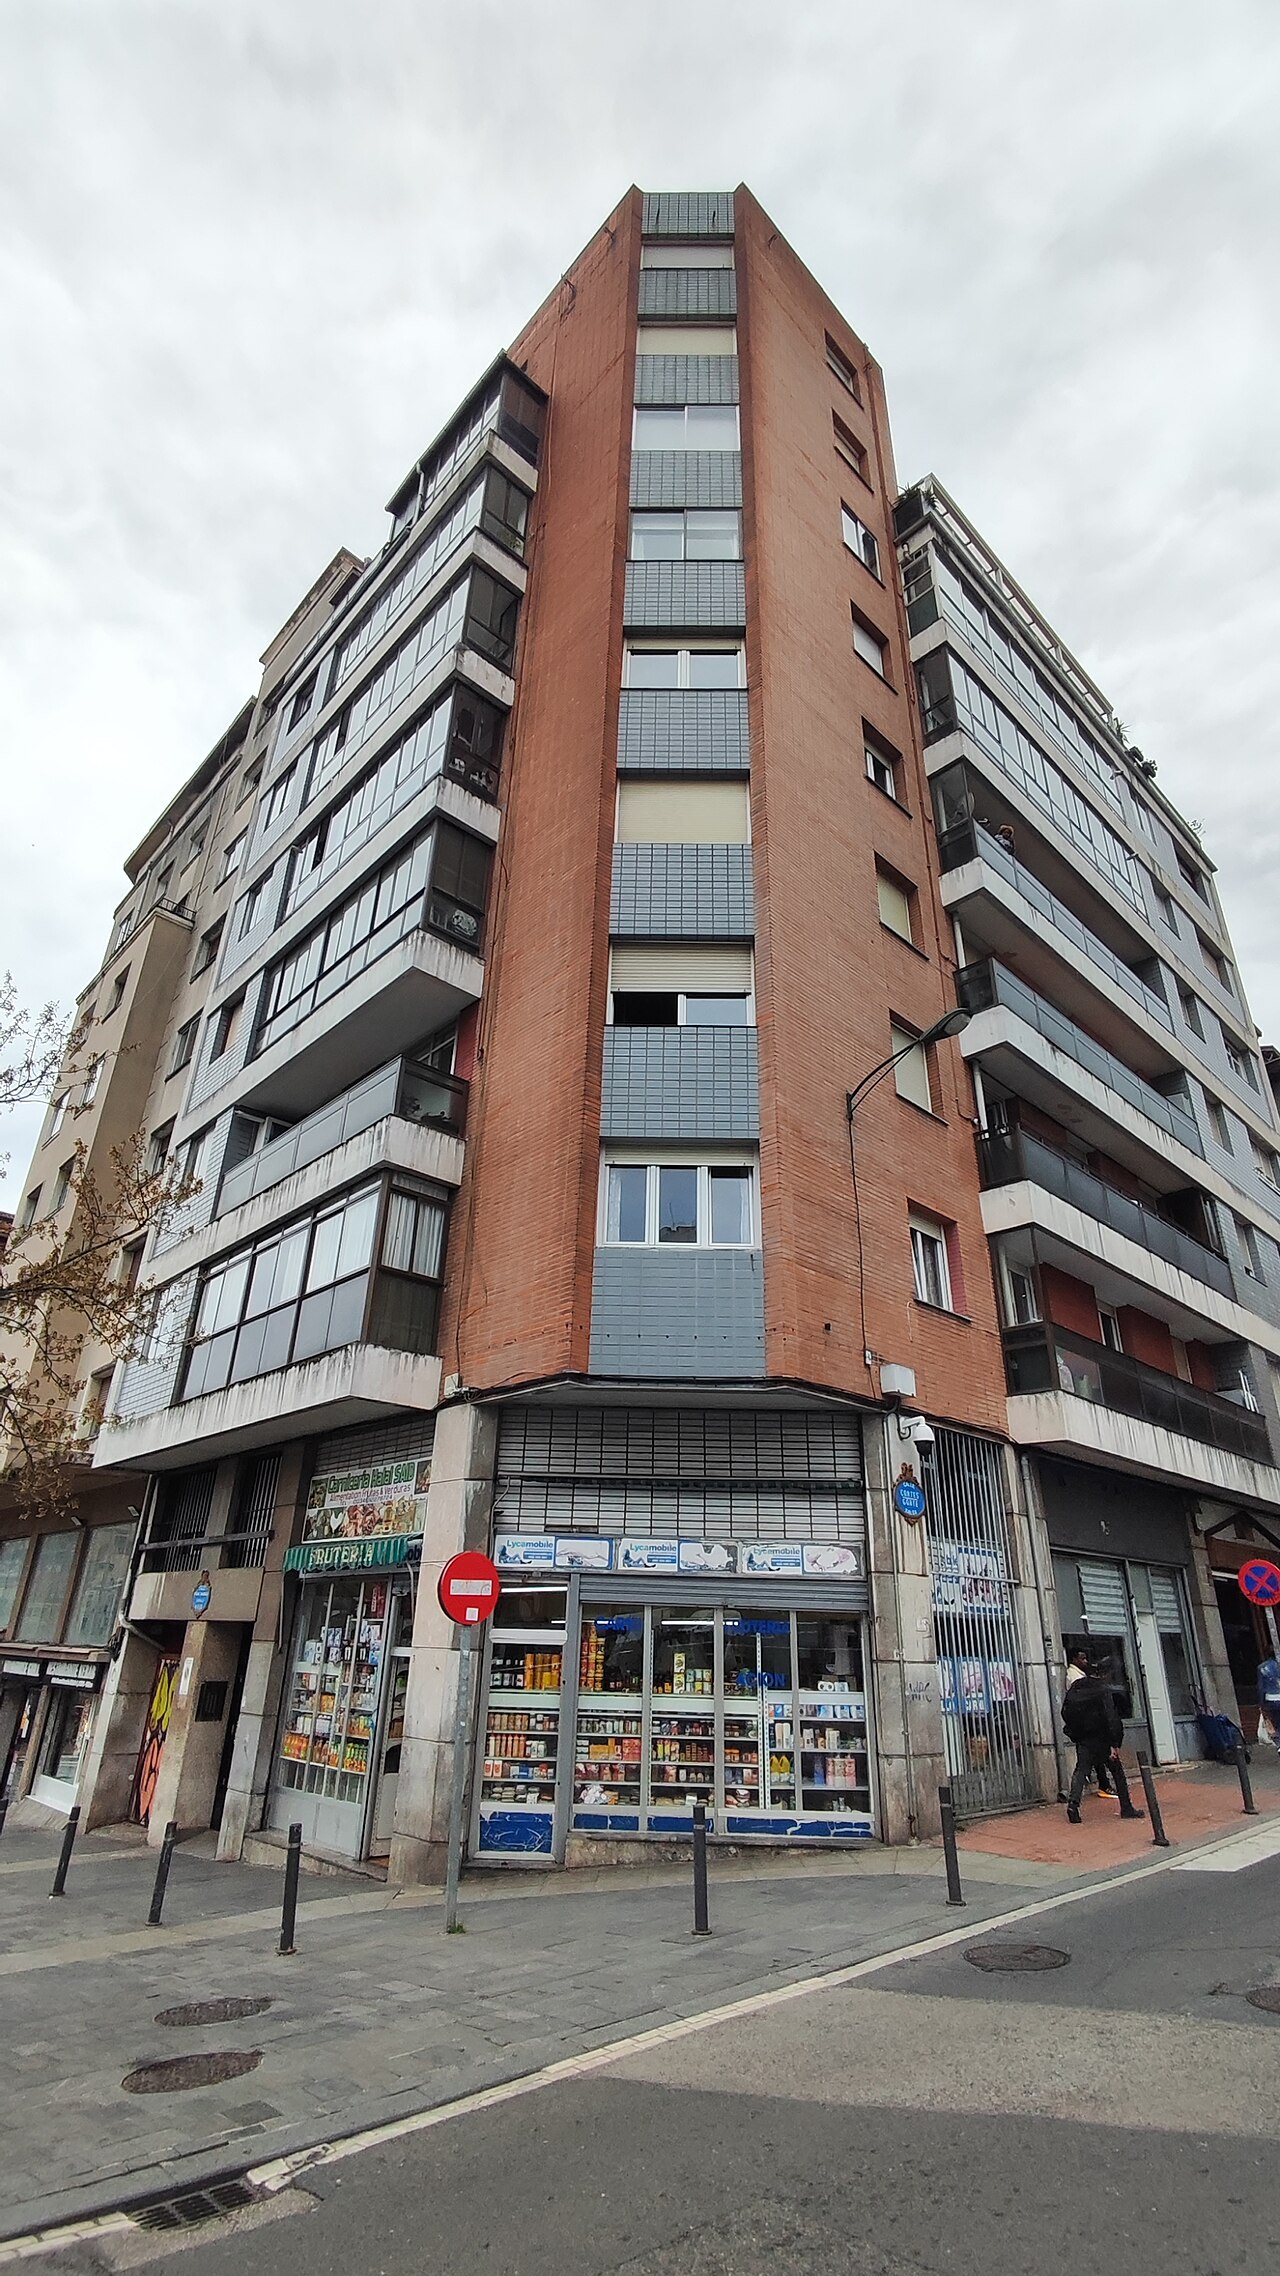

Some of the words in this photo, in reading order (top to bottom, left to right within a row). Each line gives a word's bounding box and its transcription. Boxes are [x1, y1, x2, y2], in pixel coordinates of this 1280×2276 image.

[370, 1465, 394, 1488] Halal
[394, 1462, 416, 1484] SAID
[384, 1484, 411, 1496] Verduras
[900, 1489, 920, 1499] CORTES
[506, 1539, 553, 1549] Lycamobile
[630, 1542, 677, 1552] Lycamobile
